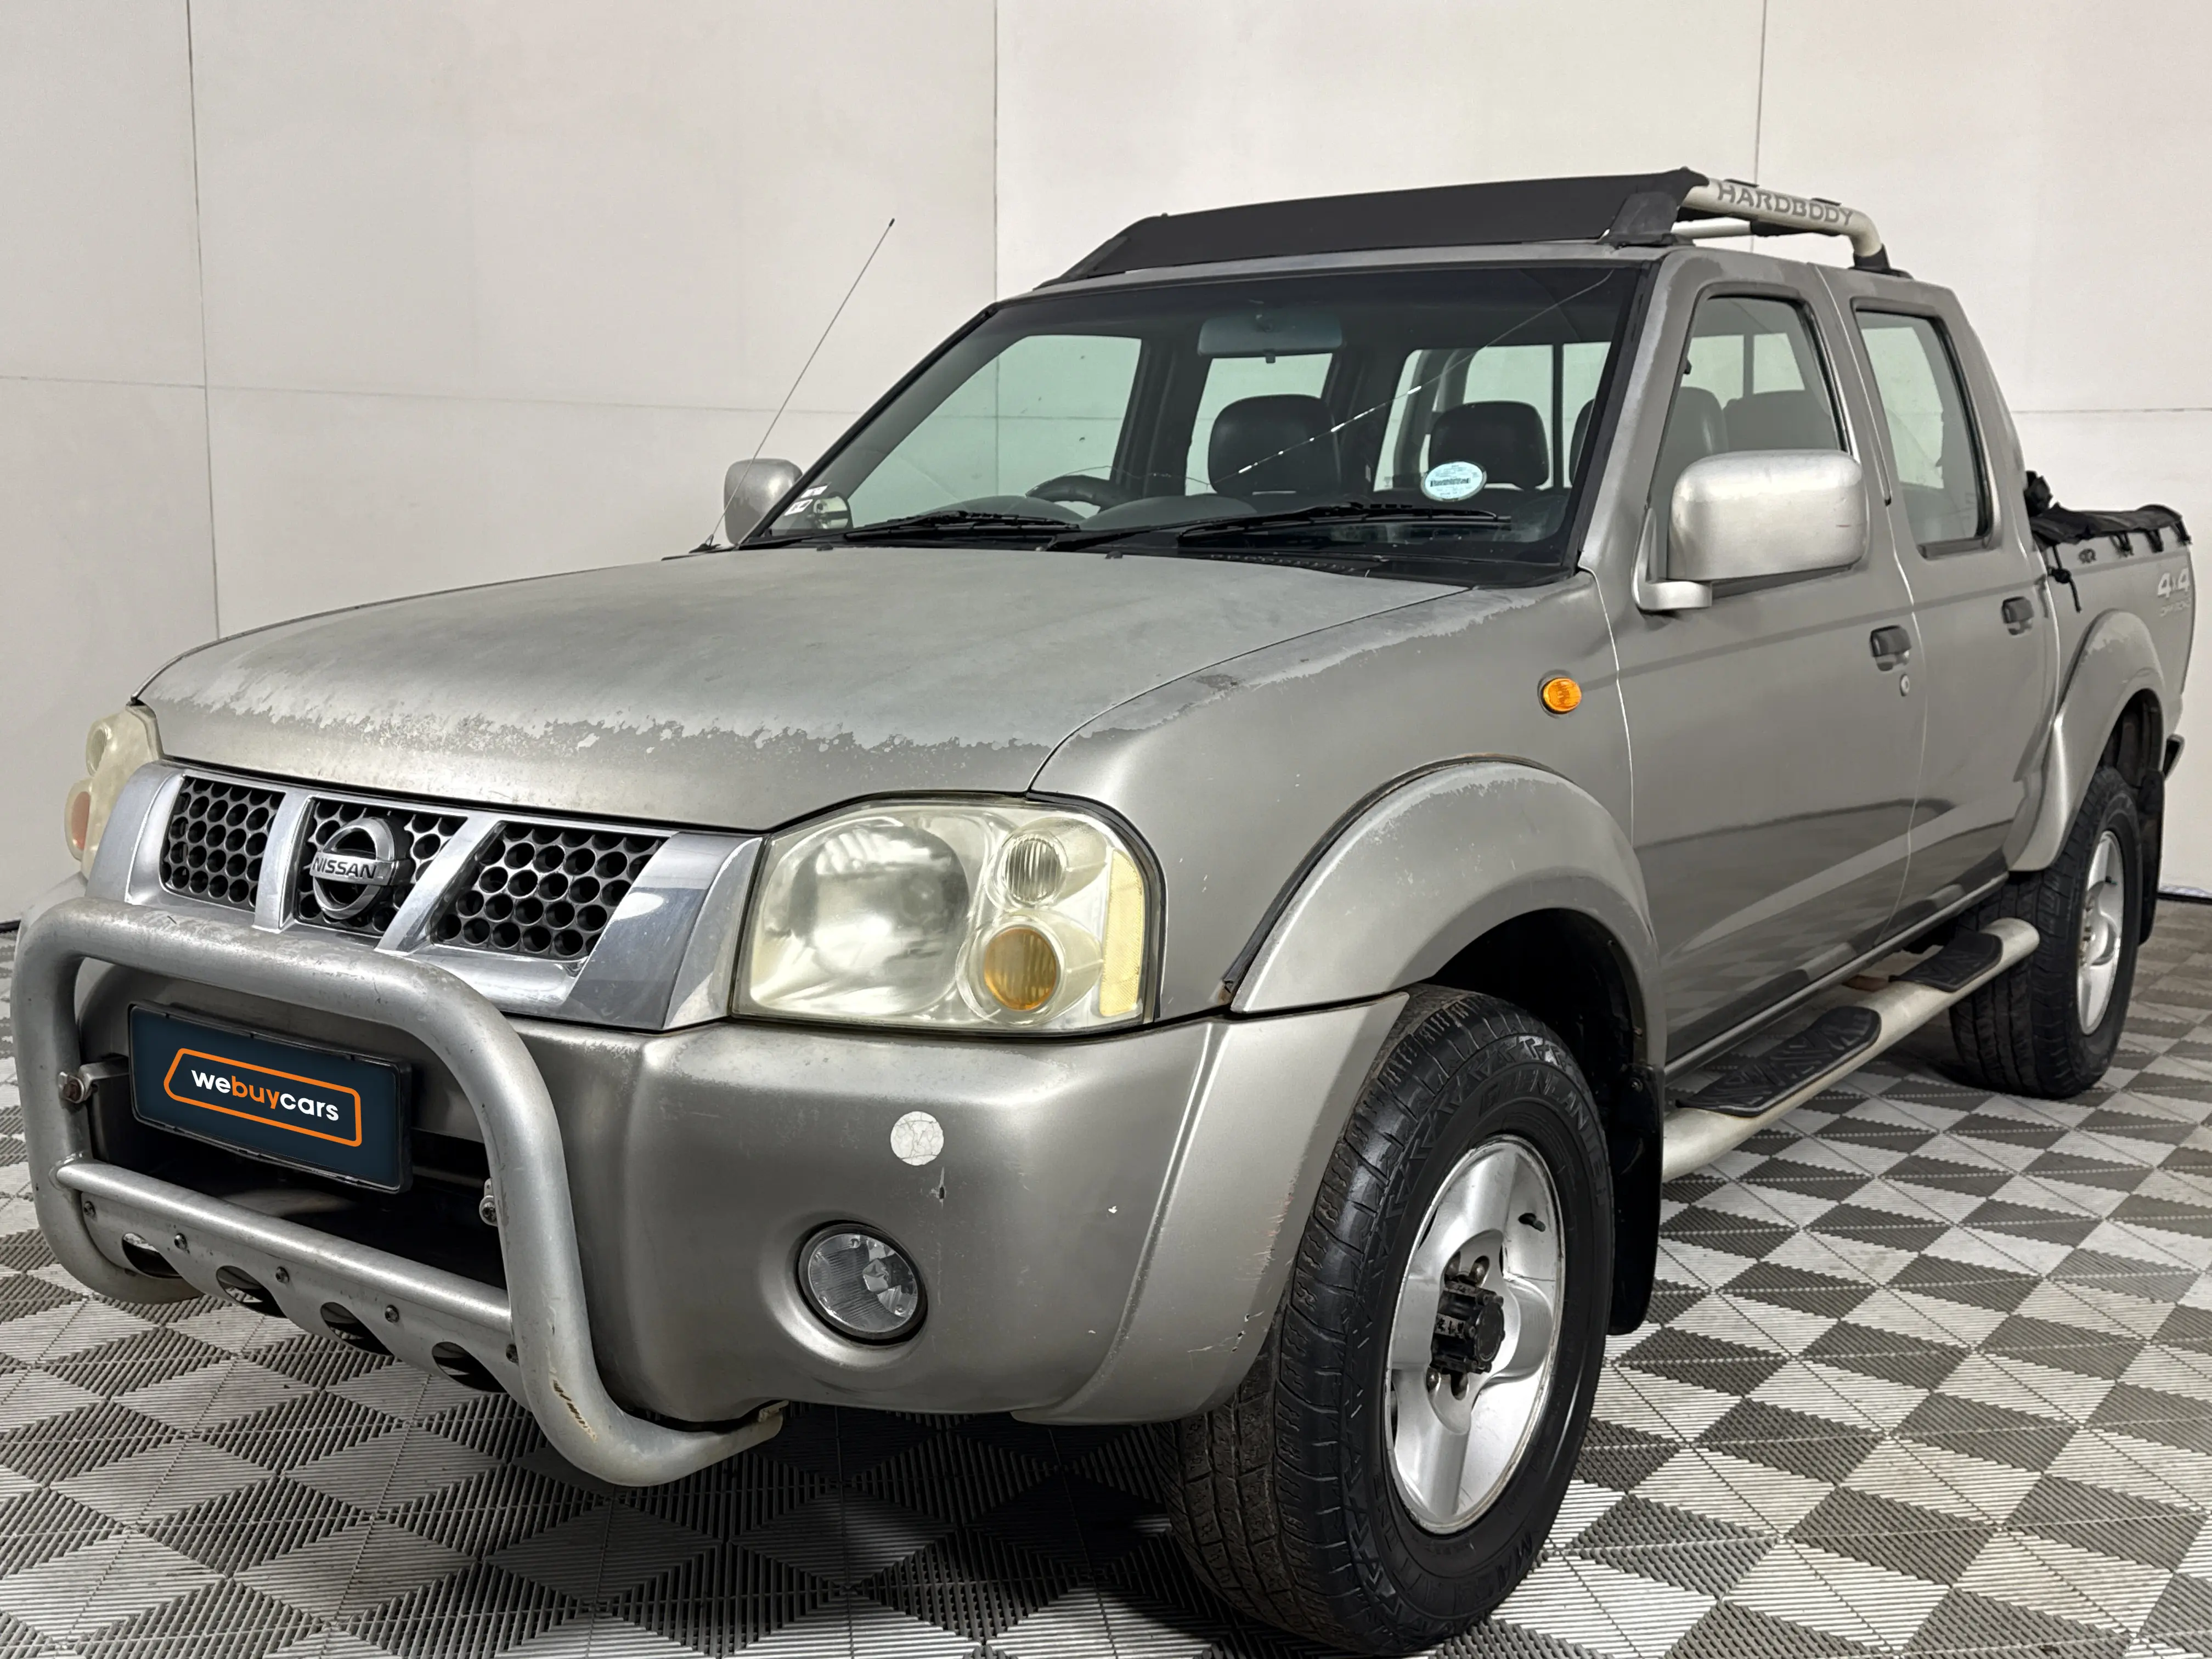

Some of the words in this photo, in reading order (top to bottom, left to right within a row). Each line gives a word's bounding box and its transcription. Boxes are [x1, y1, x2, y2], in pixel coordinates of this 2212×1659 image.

[1717, 182, 1854, 226] HARDBODY
[312, 856, 377, 879] NISSAN
[190, 1069, 340, 1122] webuycars
